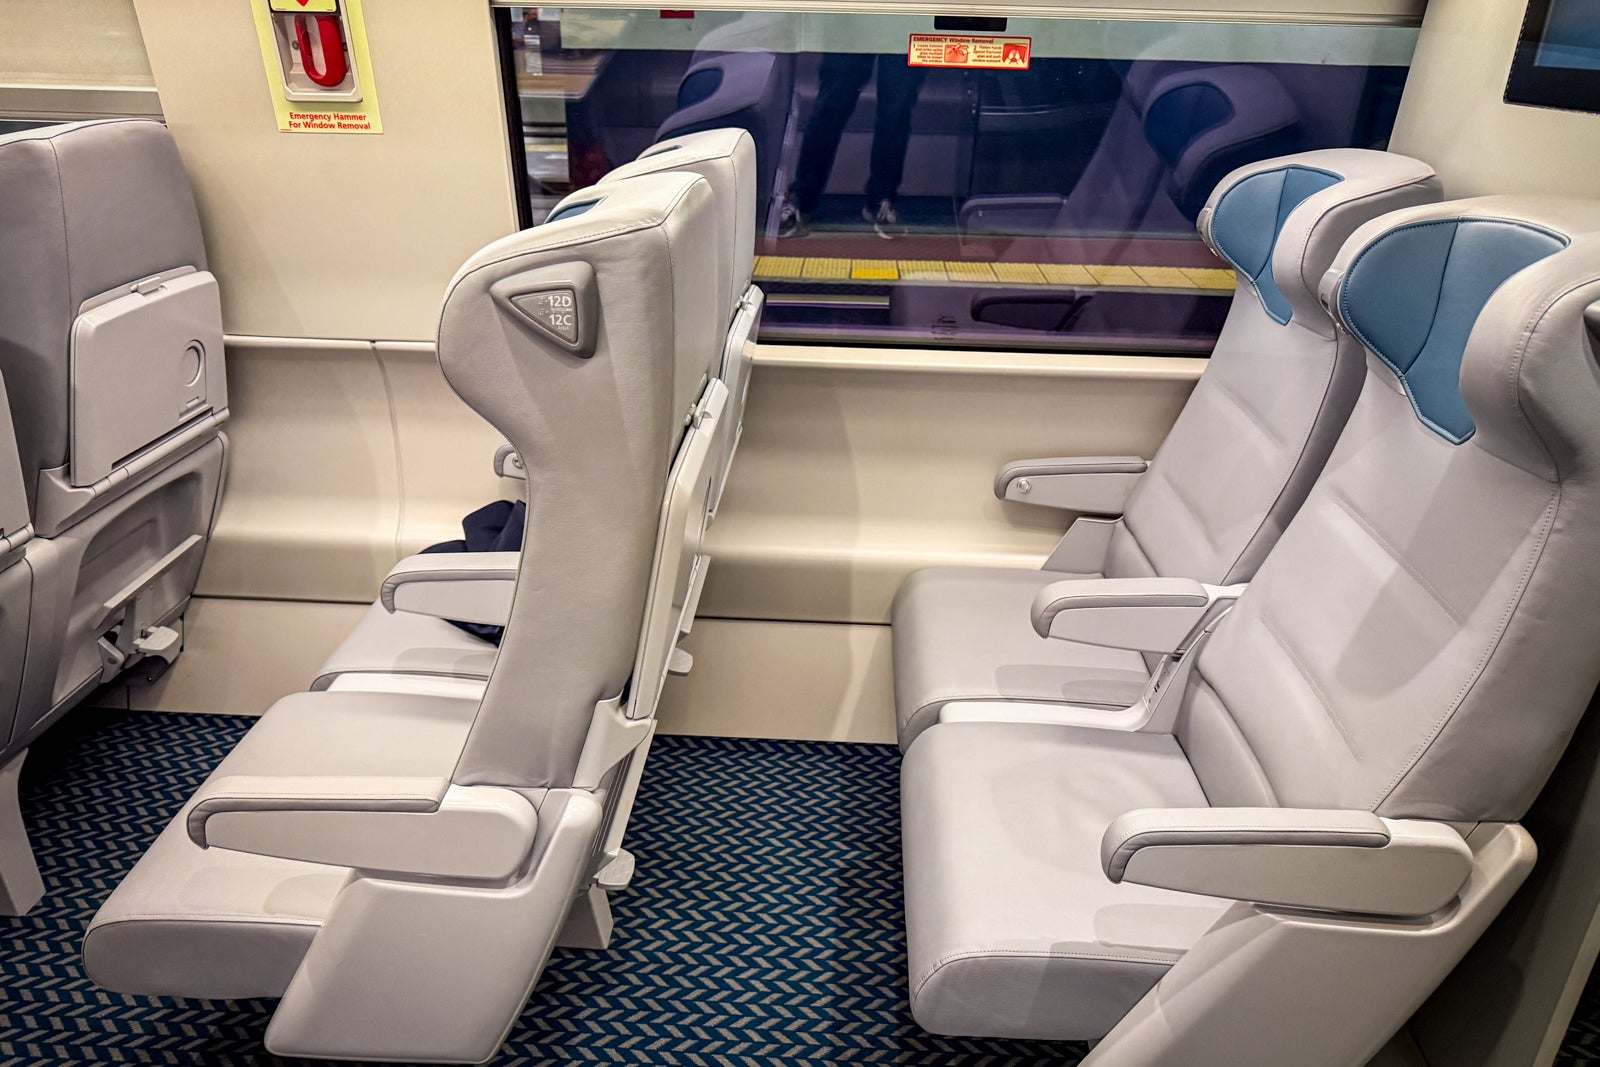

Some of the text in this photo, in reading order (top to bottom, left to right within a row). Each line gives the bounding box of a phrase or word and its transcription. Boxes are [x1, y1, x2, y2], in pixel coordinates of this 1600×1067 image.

[289, 112, 366, 121] Emergency Hammer
[288, 120, 371, 130] For Window Removal
[547, 295, 572, 307] 12D
[549, 314, 573, 326] 12C
